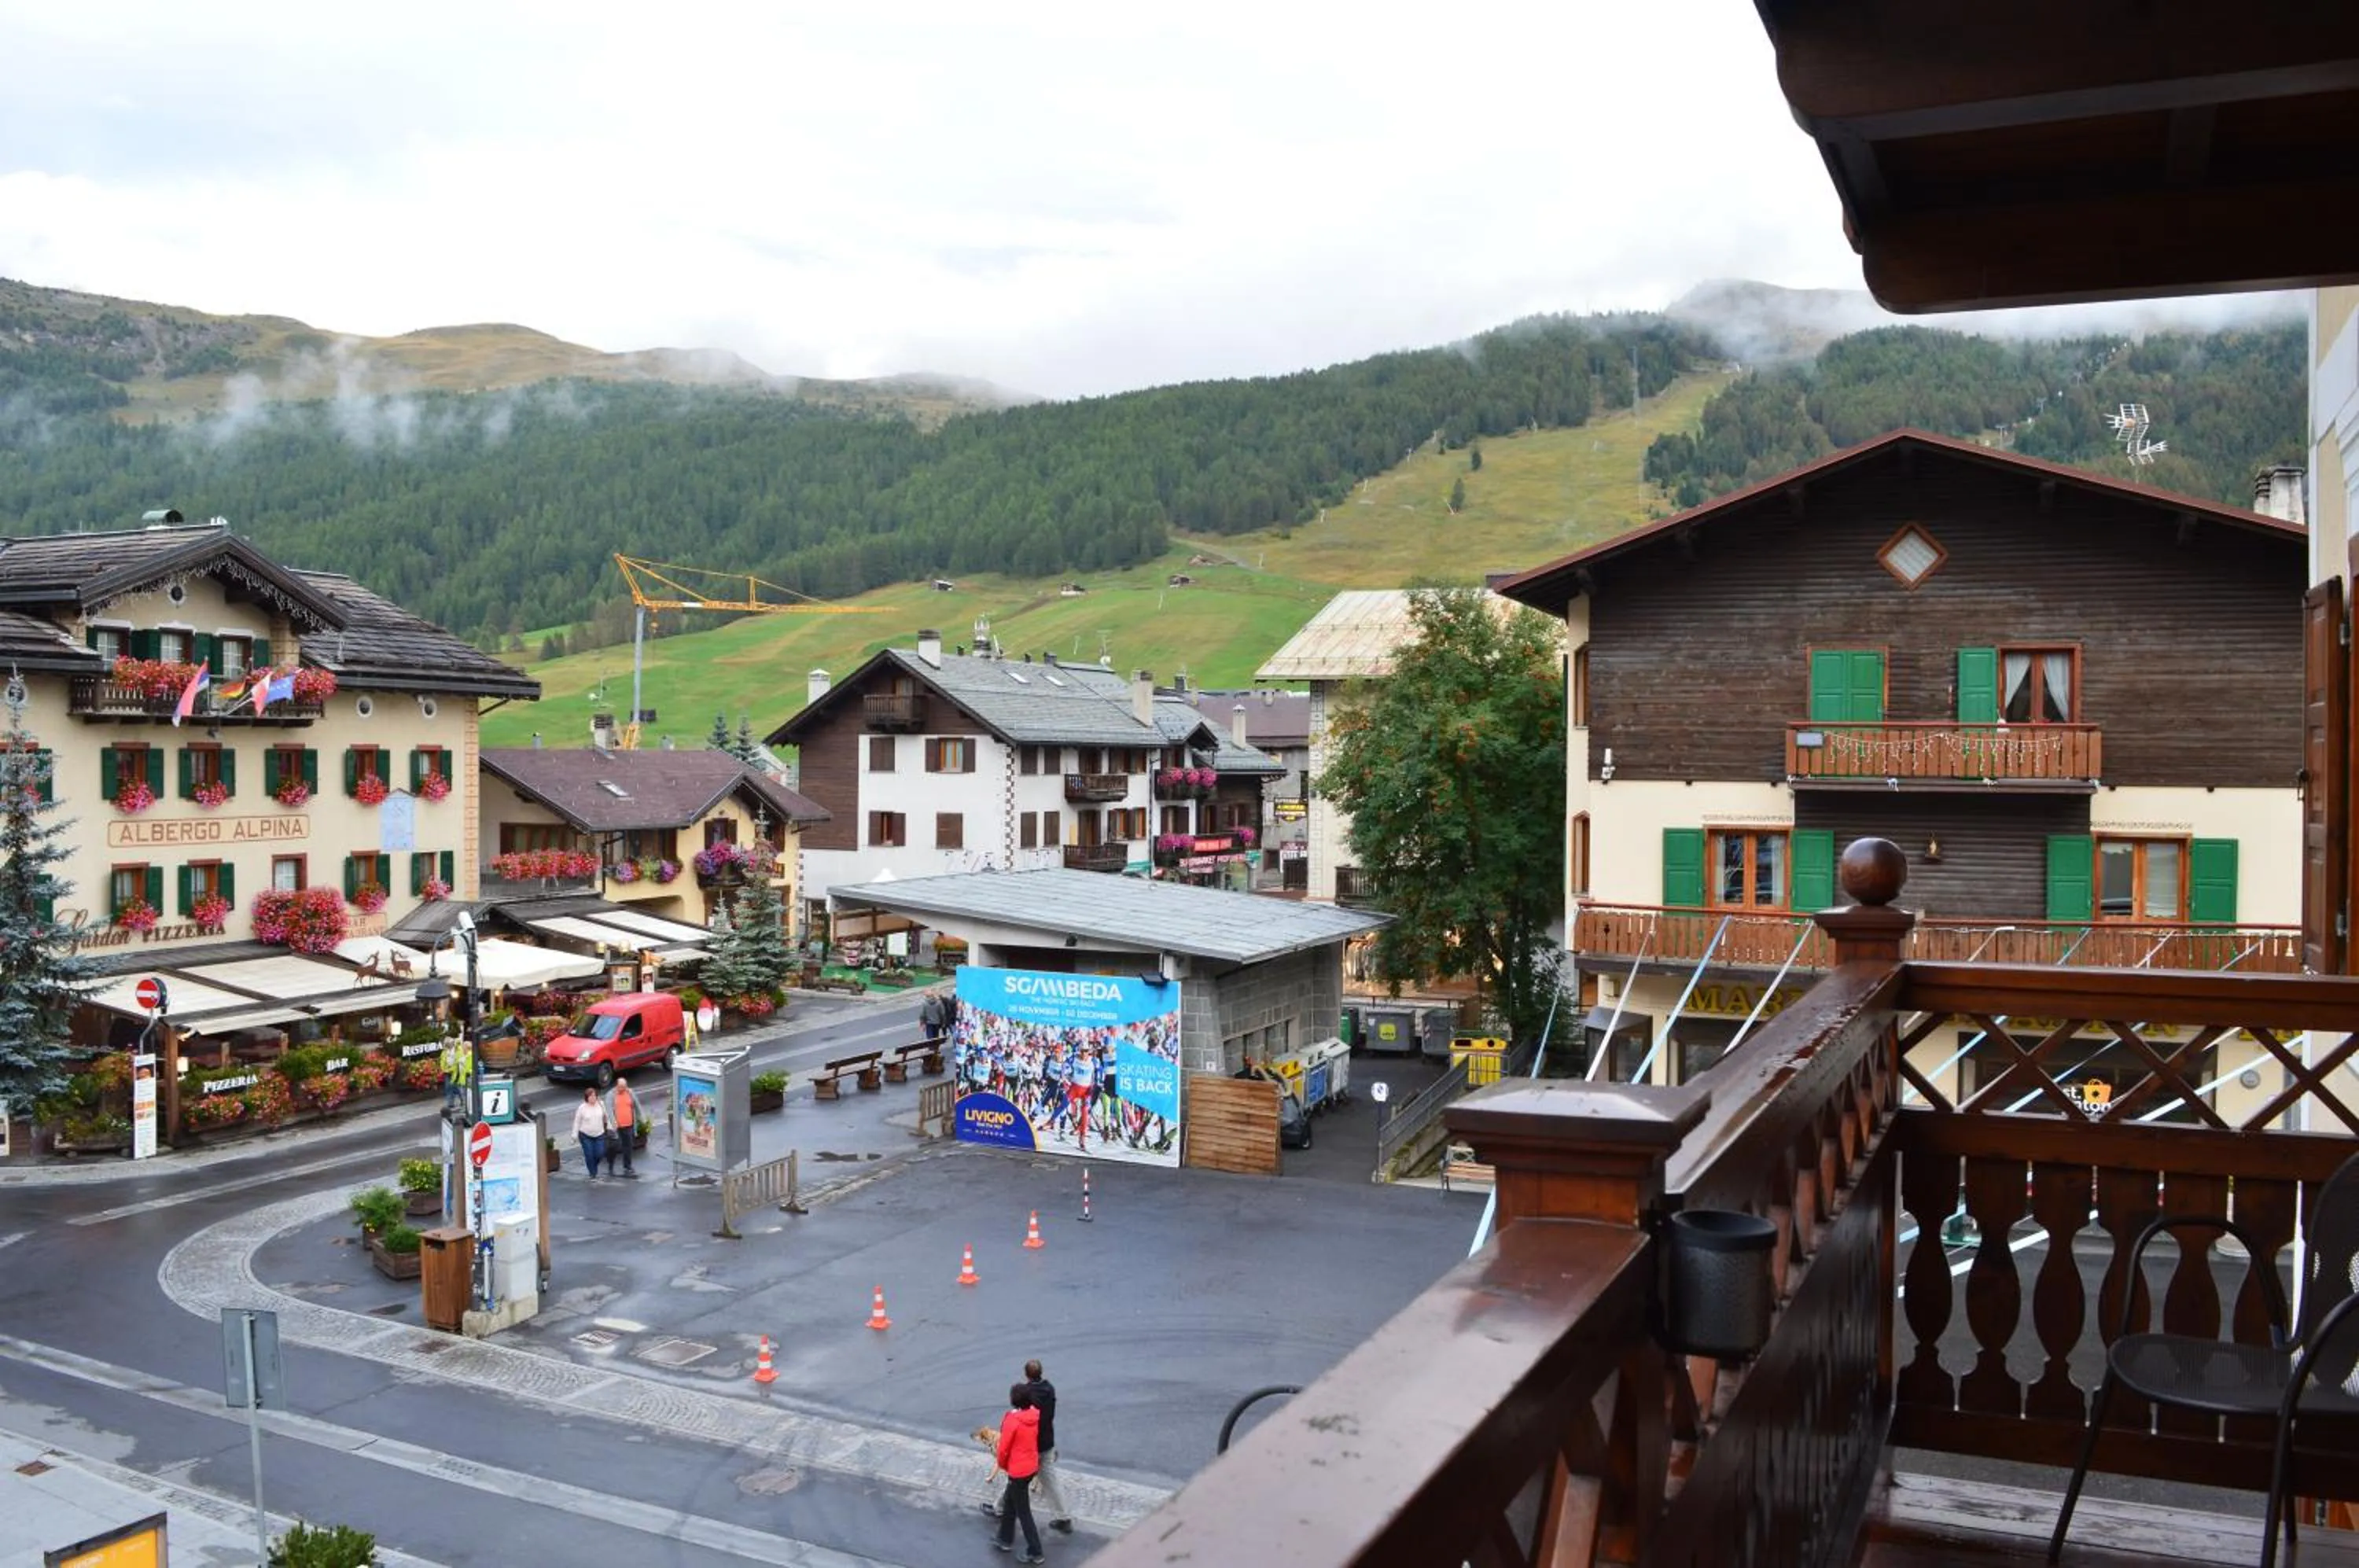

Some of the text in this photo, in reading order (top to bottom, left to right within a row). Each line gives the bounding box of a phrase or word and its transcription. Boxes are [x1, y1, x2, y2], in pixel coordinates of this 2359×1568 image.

[120, 819, 304, 843] ALBERGO ALPINA
[326, 1058, 349, 1072] BAR
[1120, 1063, 1172, 1080] SKATING
[203, 1074, 259, 1093] PIZZERIA
[1120, 1077, 1174, 1095] IS BACK
[965, 1108, 1014, 1125] LIVIGNO
